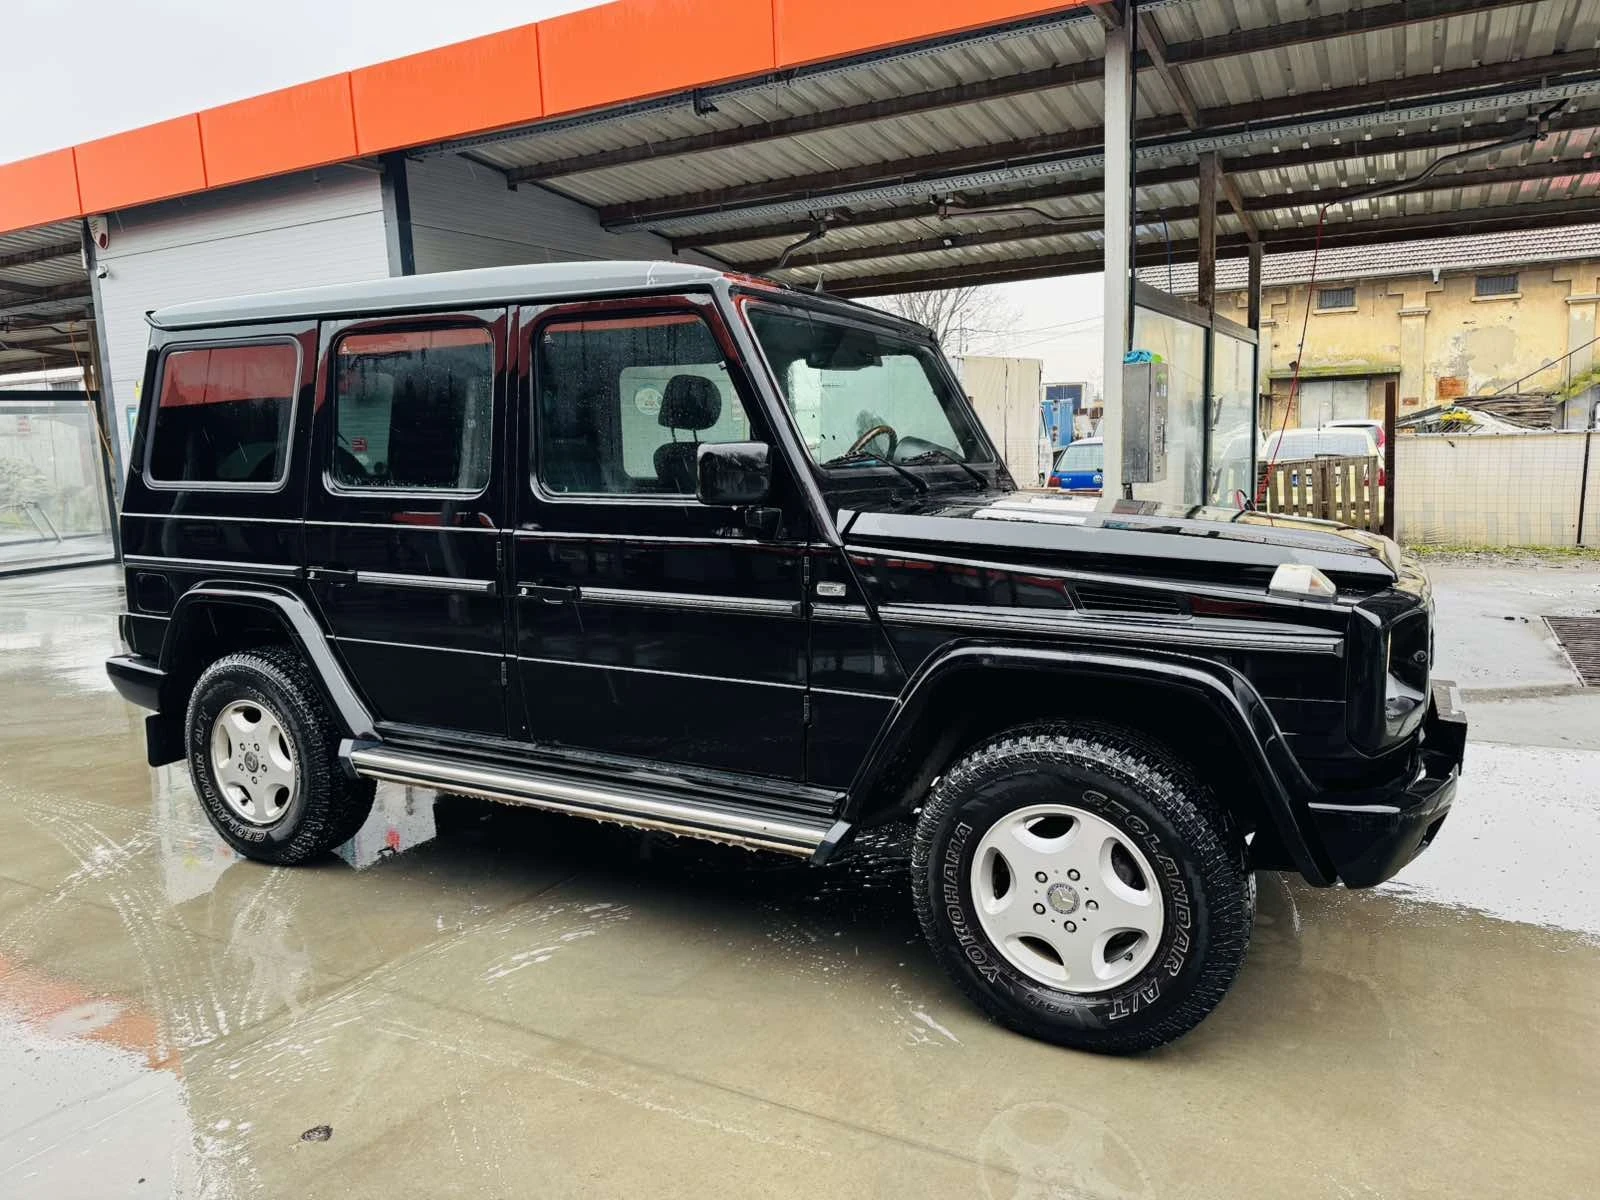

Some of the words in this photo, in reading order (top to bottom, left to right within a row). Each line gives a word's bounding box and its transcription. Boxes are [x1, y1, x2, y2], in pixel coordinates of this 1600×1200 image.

[943, 821, 997, 984] YOKOHAMA
[1081, 789, 1192, 977] GEOLANDAR
[1108, 979, 1162, 1020] A/T
